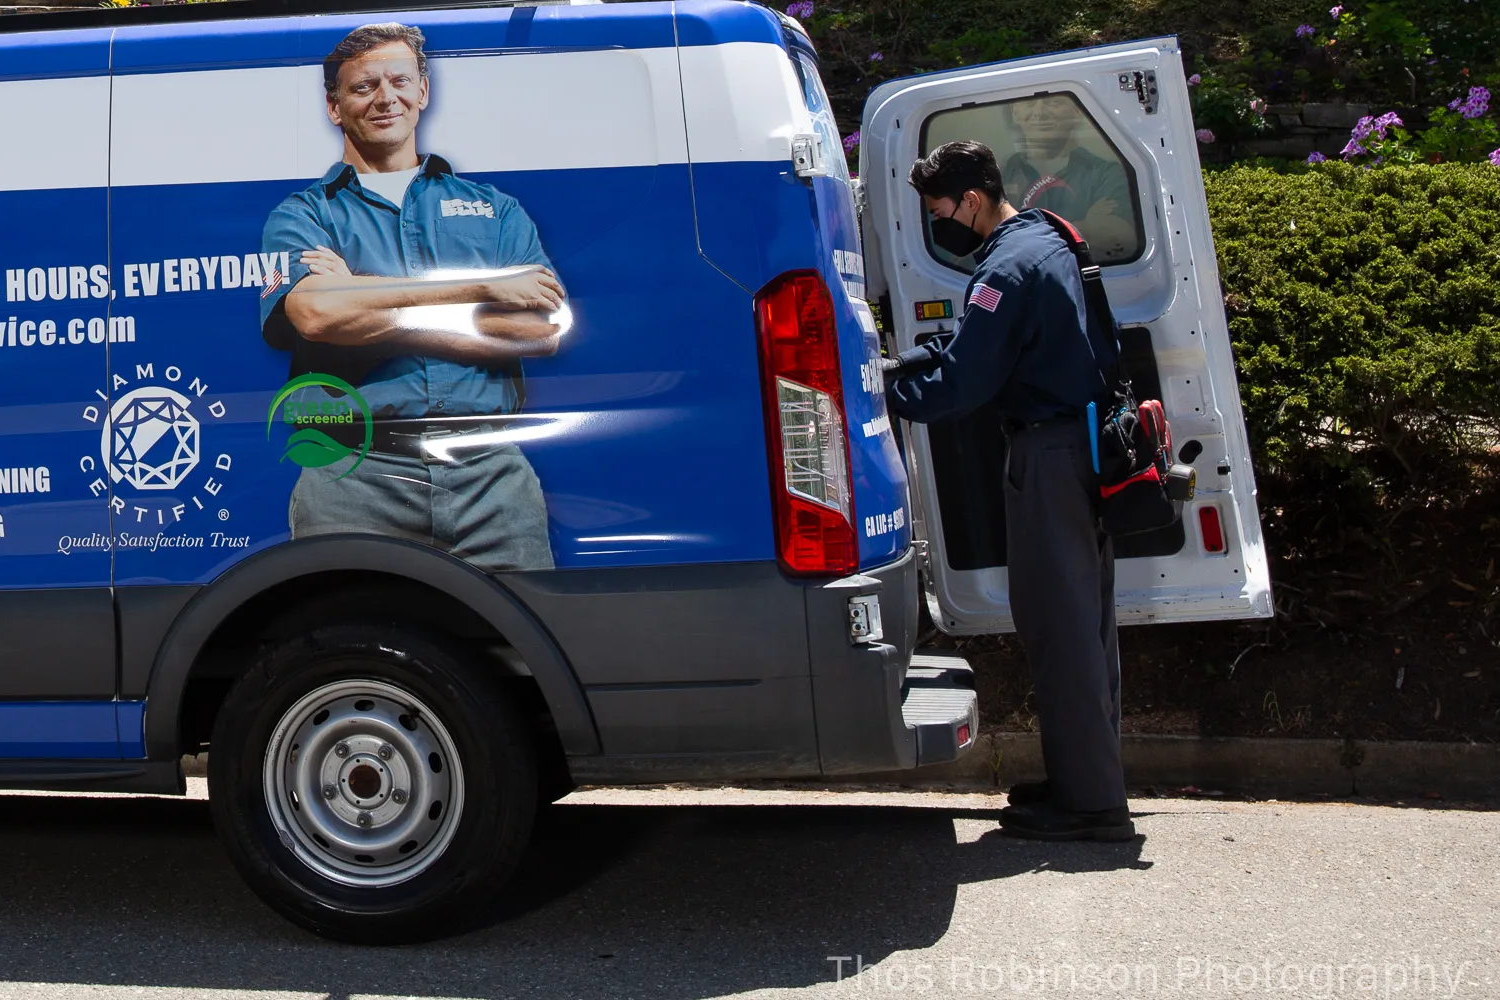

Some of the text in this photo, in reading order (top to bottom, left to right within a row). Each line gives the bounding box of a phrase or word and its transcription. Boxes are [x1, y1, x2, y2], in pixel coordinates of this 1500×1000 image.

[5, 264, 116, 302] HOURS,
[123, 251, 291, 298] EVERYDAY!
[83, 362, 226, 424] DIAMOND
[283, 400, 349, 425] green
[296, 408, 353, 424] screened
[79, 453, 232, 525] CERTIFIED
[57, 531, 250, 555] Quality Satisfaction Trust
